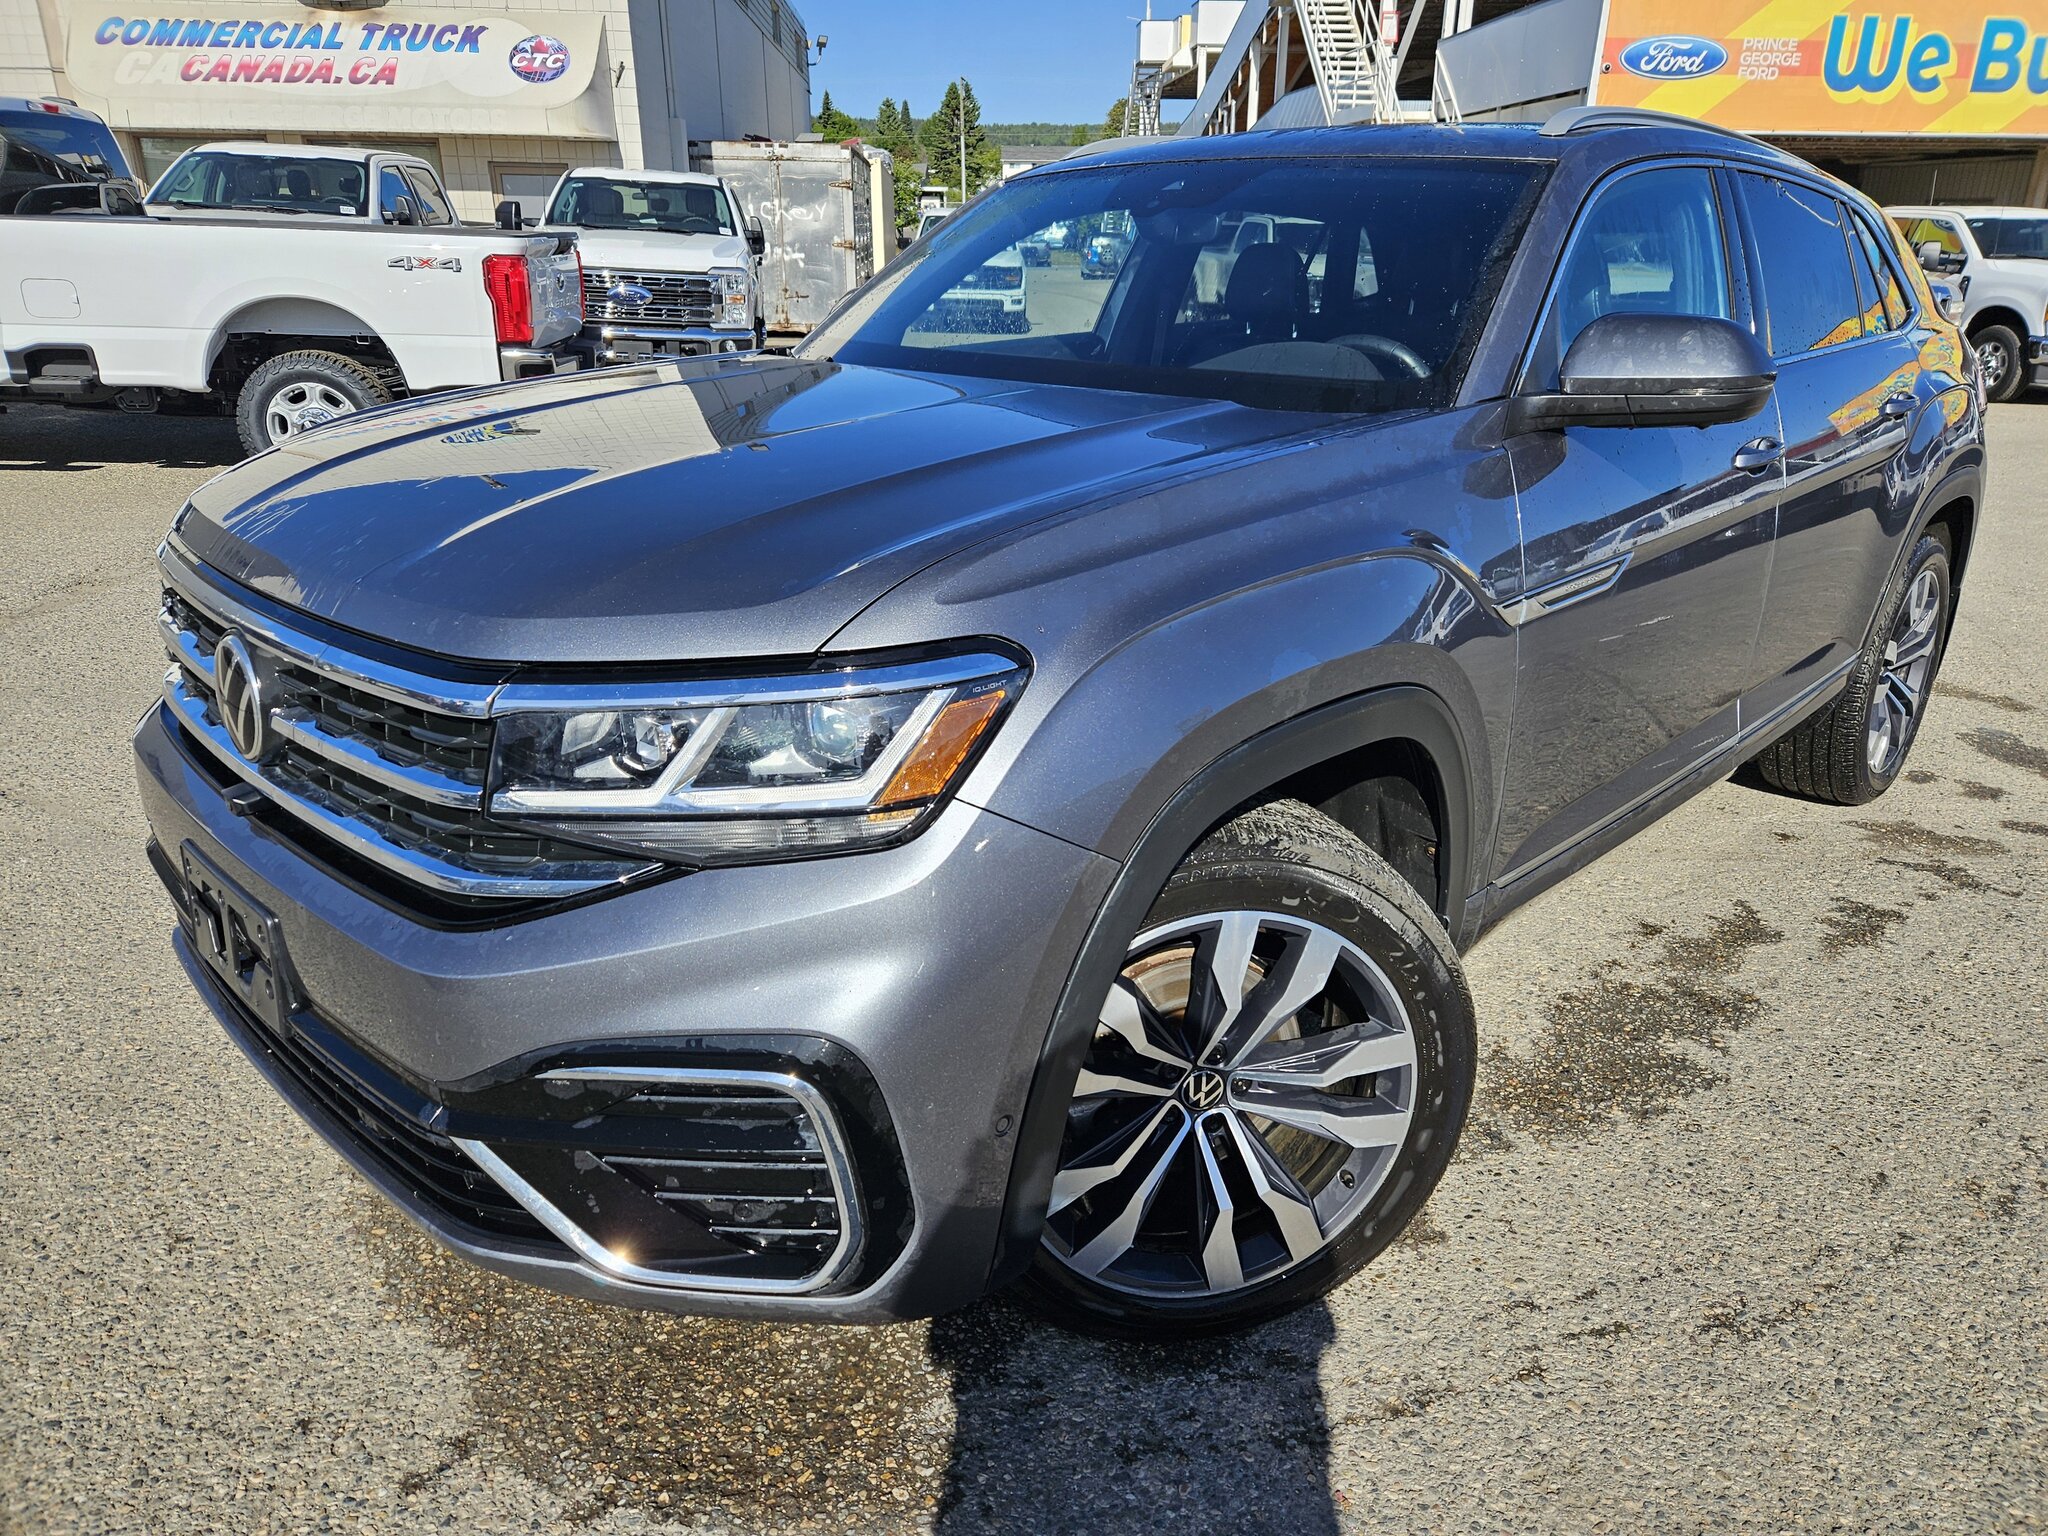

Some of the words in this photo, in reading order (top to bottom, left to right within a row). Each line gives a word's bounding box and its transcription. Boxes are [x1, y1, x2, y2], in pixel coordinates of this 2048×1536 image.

[94, 16, 344, 50] COMMERCIAL
[358, 22, 489, 53] TRUCK
[1743, 37, 1799, 51] PRINCE
[511, 52, 566, 69] CTC
[1640, 41, 1709, 72] Ford
[1739, 52, 1802, 66] GEORGE
[1823, 15, 1951, 94] We
[180, 54, 399, 85] CANADA.CA
[1737, 67, 1779, 80] FORD
